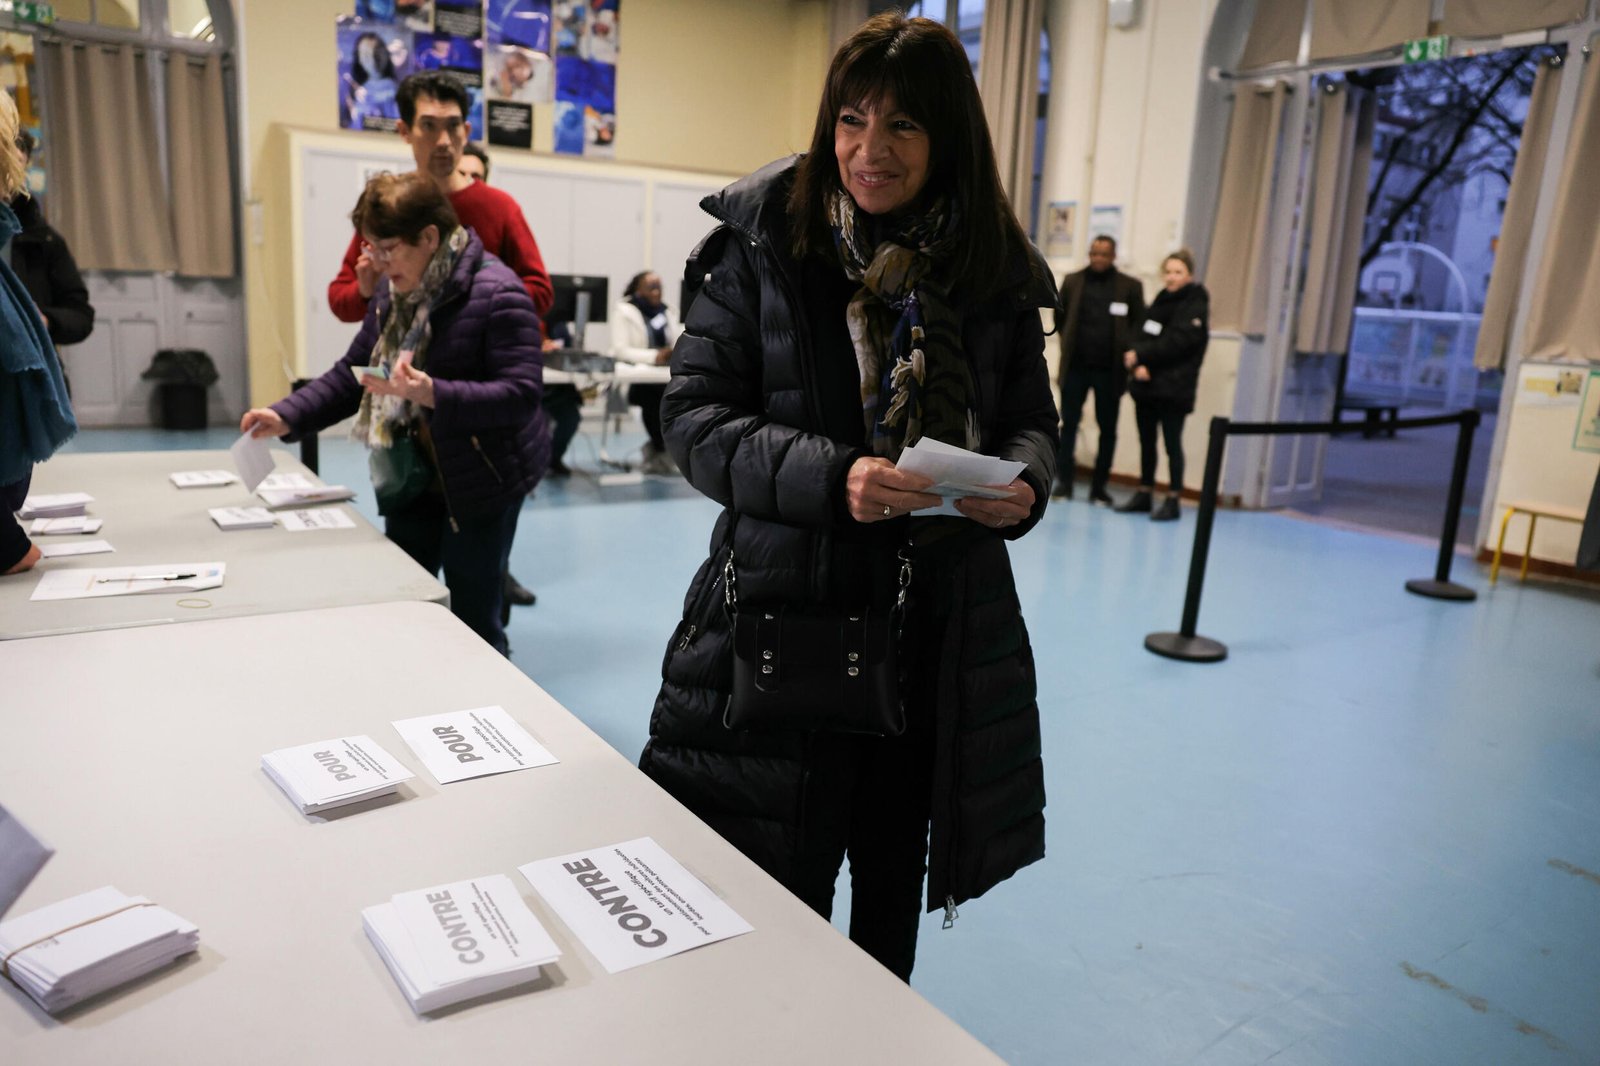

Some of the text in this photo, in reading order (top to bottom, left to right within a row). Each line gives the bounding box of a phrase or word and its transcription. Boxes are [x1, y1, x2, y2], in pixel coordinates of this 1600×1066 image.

[433, 726, 484, 763] POUR
[313, 750, 357, 781] POUR
[614, 849, 639, 870] individuelles
[634, 858, 657, 876] polluantes
[637, 870, 655, 885] voitures
[653, 885, 663, 893] des
[562, 858, 667, 948] CONTRE
[625, 871, 673, 915] un tarif spécifique
[661, 893, 694, 921] stationnement
[426, 890, 485, 964] CONTRE
[696, 925, 711, 935] pour
